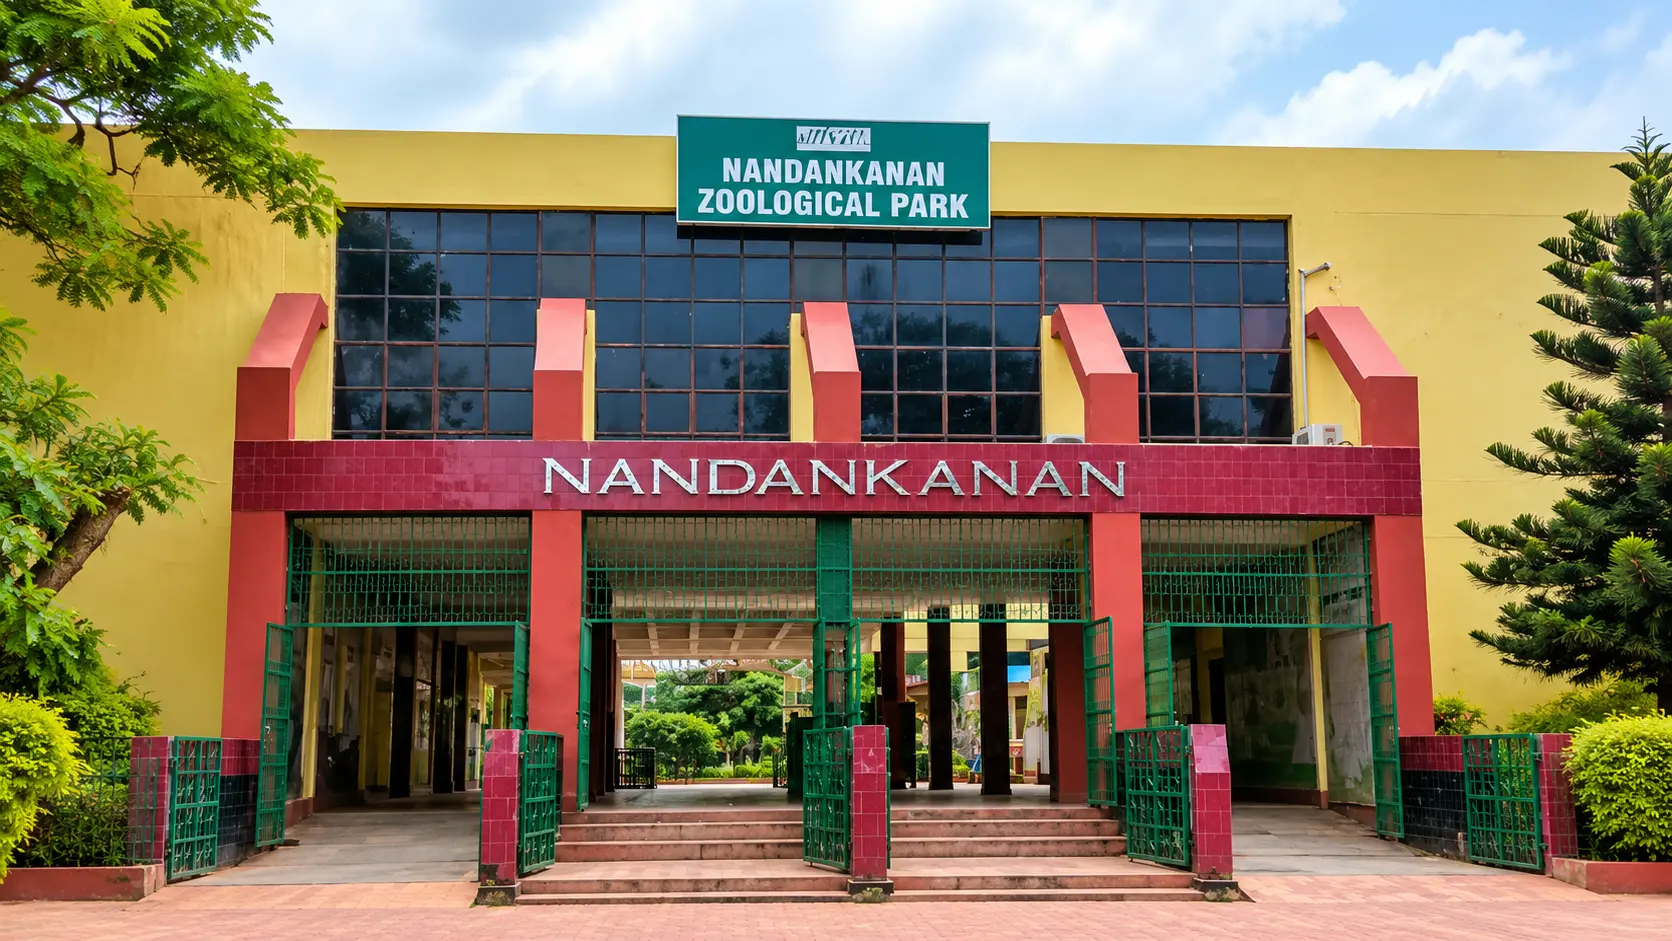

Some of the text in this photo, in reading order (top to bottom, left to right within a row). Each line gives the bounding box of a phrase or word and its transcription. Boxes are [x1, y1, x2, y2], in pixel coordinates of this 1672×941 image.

[723, 157, 945, 187] NANDANKANAN
[698, 188, 969, 219] ZOOLOGICAL PARK
[543, 457, 1126, 498] NANDANKANAN
